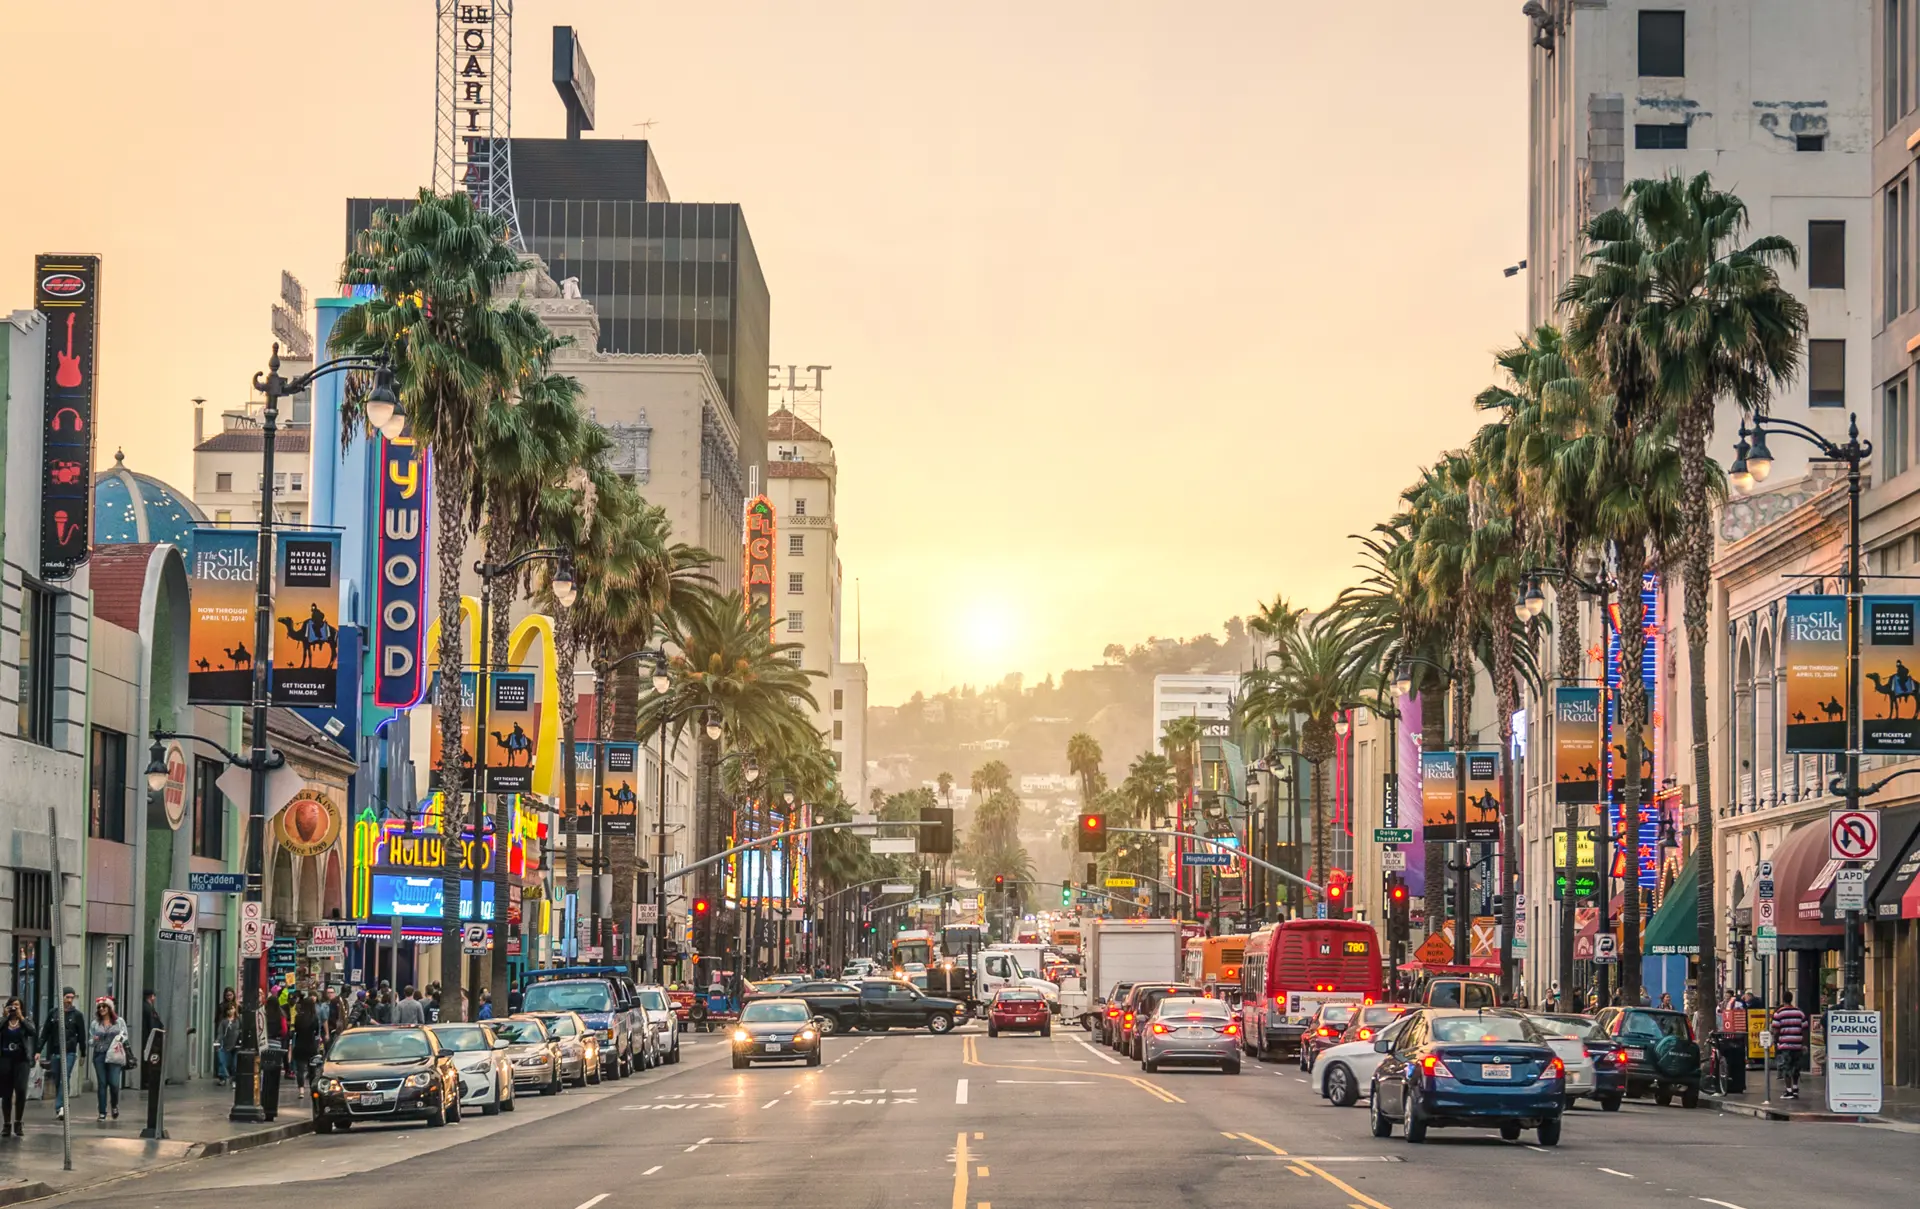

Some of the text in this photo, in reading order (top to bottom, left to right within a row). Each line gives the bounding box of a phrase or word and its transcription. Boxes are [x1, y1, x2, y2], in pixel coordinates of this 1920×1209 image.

[750, 514, 772, 535] EL
[204, 548, 249, 567] The Silk
[202, 560, 253, 581] Road
[1808, 611, 1838, 628] Silk
[1796, 622, 1842, 641] Road
[1572, 700, 1594, 712] Silk
[1564, 708, 1596, 722] Road
[1435, 762, 1452, 771] Silk
[1428, 768, 1454, 778] Road
[284, 840, 305, 854] Since
[192, 874, 234, 884] McCadden
[175, 933, 192, 941] HERE
[315, 928, 336, 938] ATM
[1321, 945, 1330, 954] M
[1348, 943, 1364, 952] 780
[432, 1012, 438, 1021] 5
